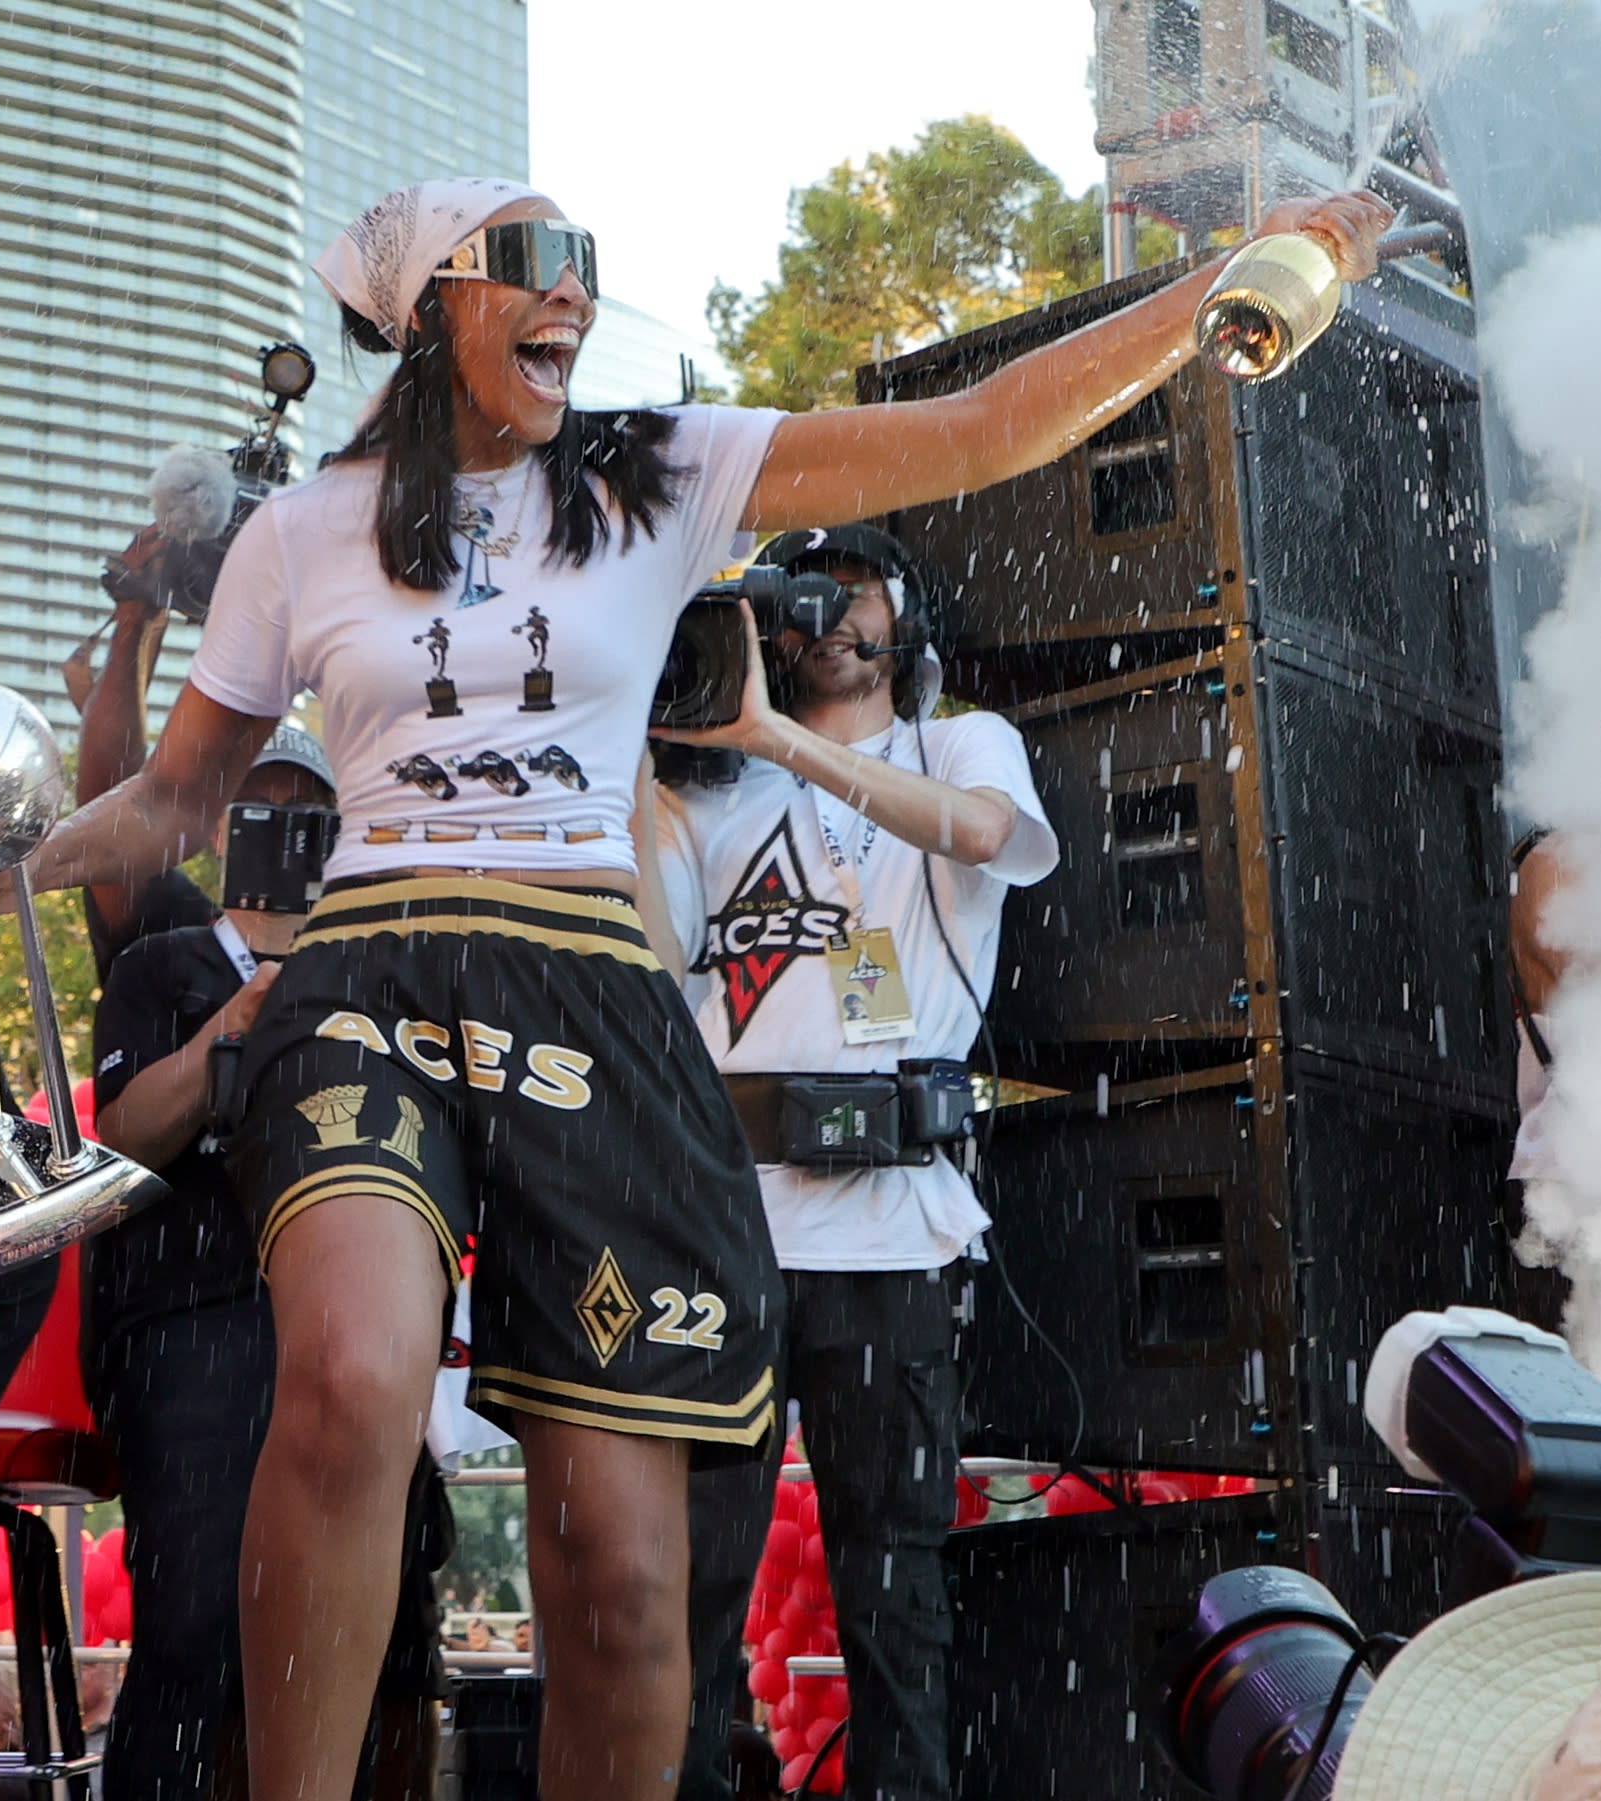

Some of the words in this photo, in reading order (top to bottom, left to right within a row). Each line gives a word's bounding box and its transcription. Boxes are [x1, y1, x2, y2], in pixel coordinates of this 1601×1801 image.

[703, 909, 842, 965] ACES
[315, 1011, 594, 1110] ACES
[646, 1287, 727, 1350] 22
